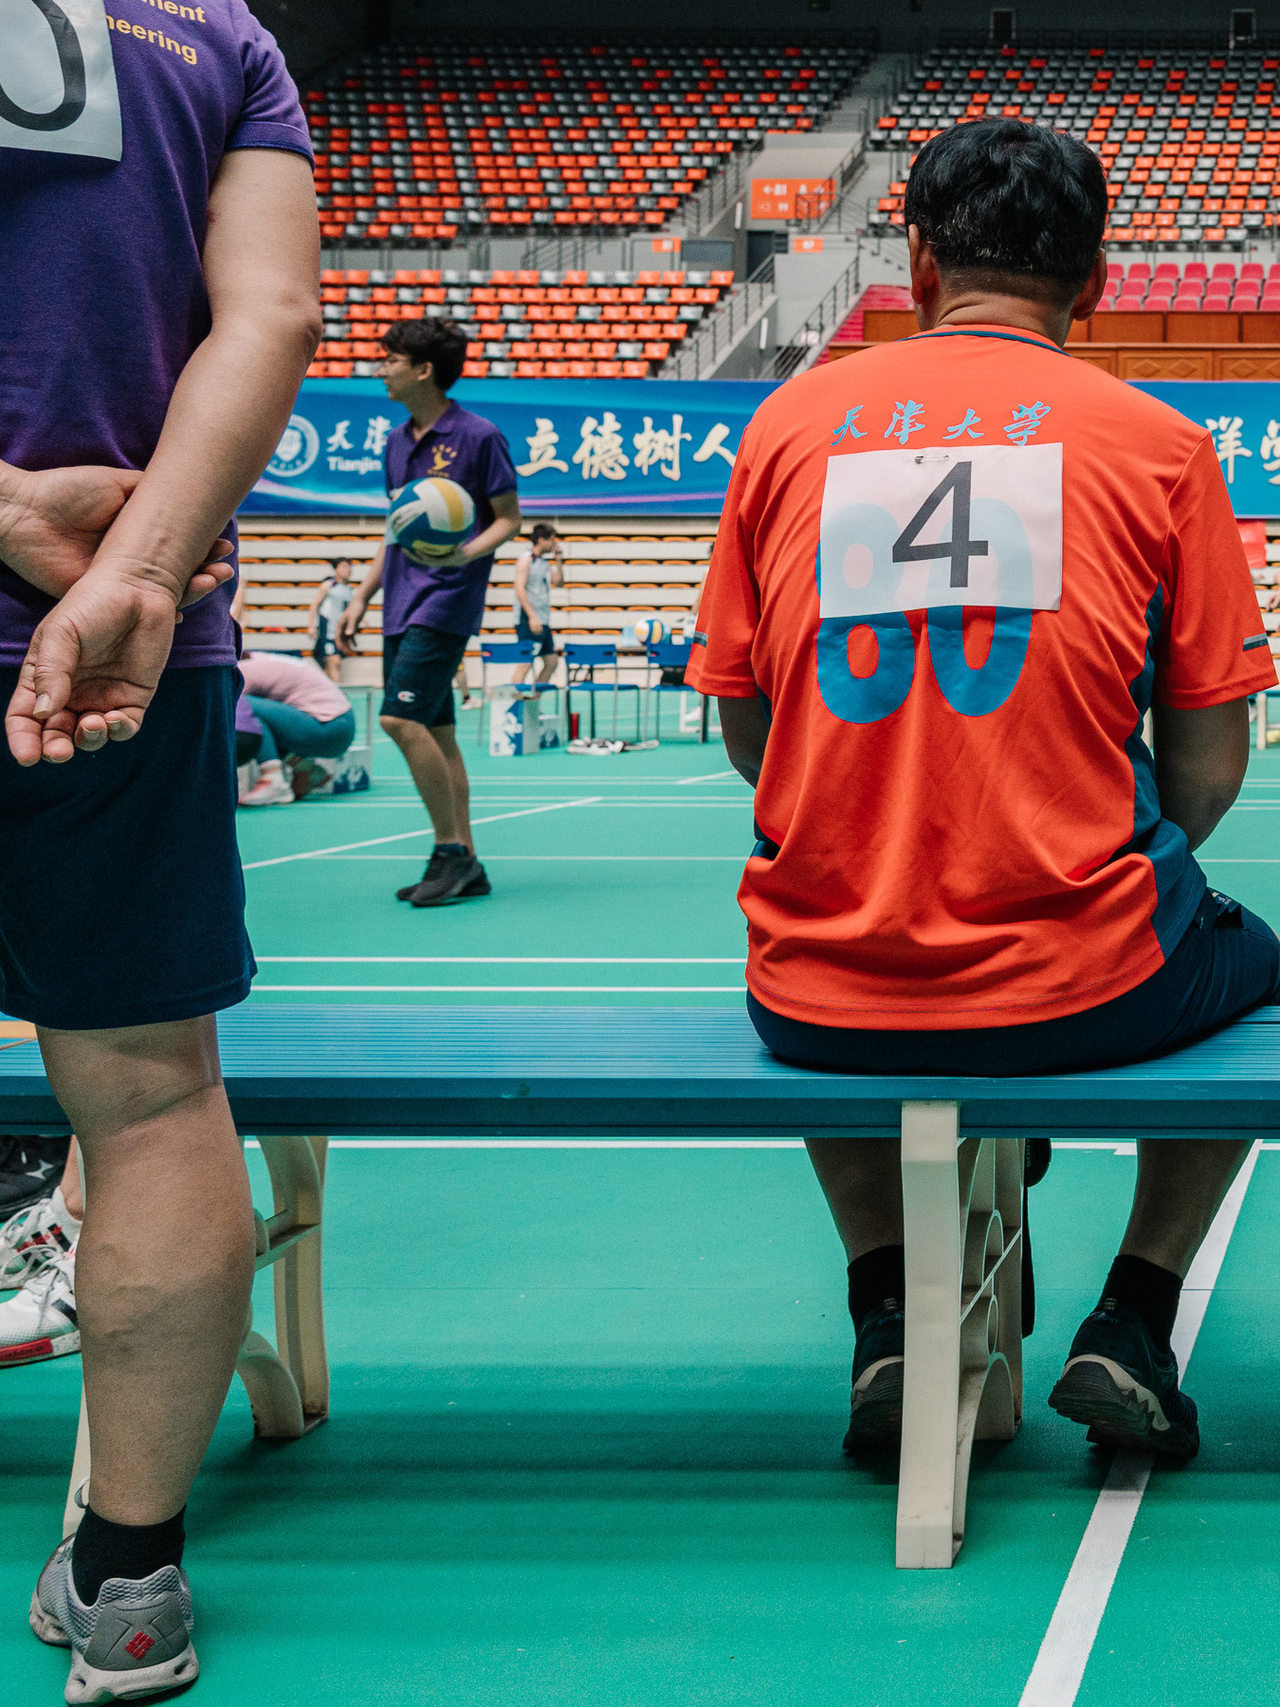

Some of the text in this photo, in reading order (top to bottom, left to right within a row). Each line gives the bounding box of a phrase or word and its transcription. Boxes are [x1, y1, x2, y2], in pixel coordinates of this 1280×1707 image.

[106, 15, 198, 65] neering
[515, 411, 736, 481] 立德树人
[831, 400, 1053, 446] 天津大学
[327, 456, 383, 475] Tianjin
[892, 460, 989, 588] 4
